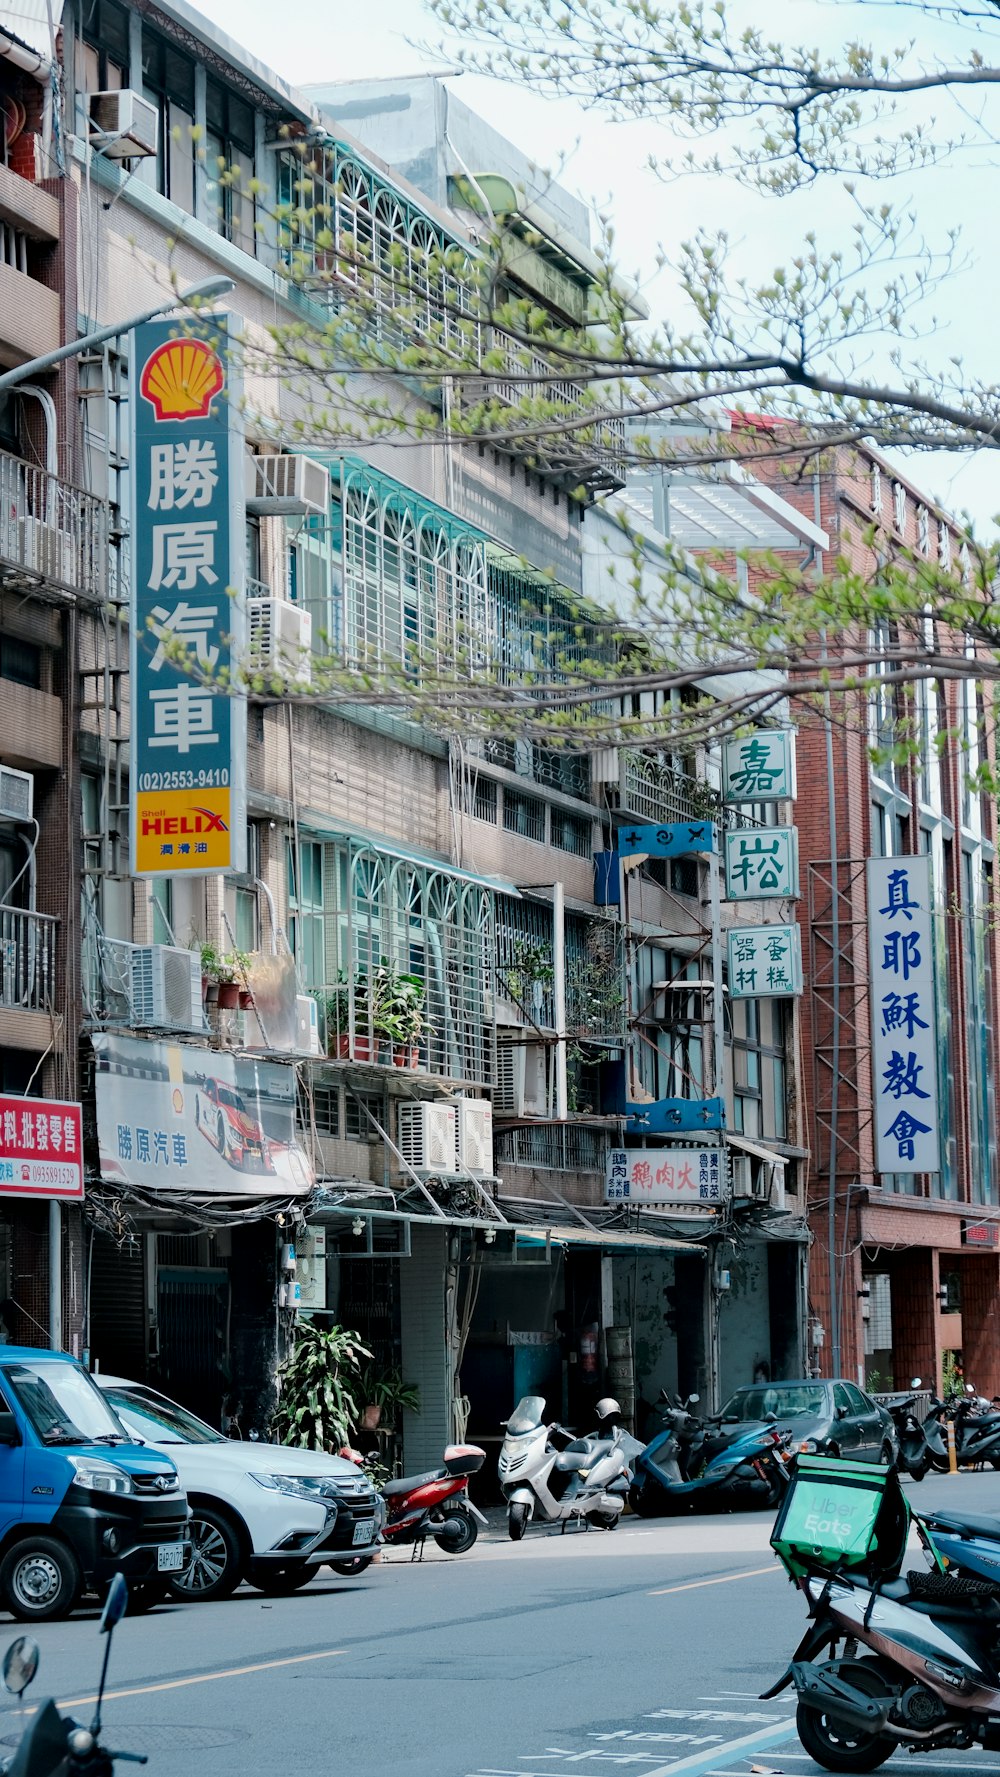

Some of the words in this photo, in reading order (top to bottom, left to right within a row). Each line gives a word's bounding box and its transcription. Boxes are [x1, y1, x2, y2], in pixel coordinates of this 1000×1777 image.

[147, 439, 219, 753] 勝原汽車
[139, 768, 229, 791] (02)2553-9410
[142, 810, 166, 818] Shell
[142, 808, 229, 836] HELIX
[160, 842, 208, 855] 潤滑油
[879, 869, 933, 1161] 真耶穌教會
[0, 1110, 76, 1153] 料.批發零售
[117, 1124, 188, 1167] 勝原汽車
[32, 1164, 75, 1185] 0935891529
[699, 1153, 709, 1199] 魯肉飯
[812, 1496, 858, 1518] Uber
[804, 1514, 852, 1536] Eats
